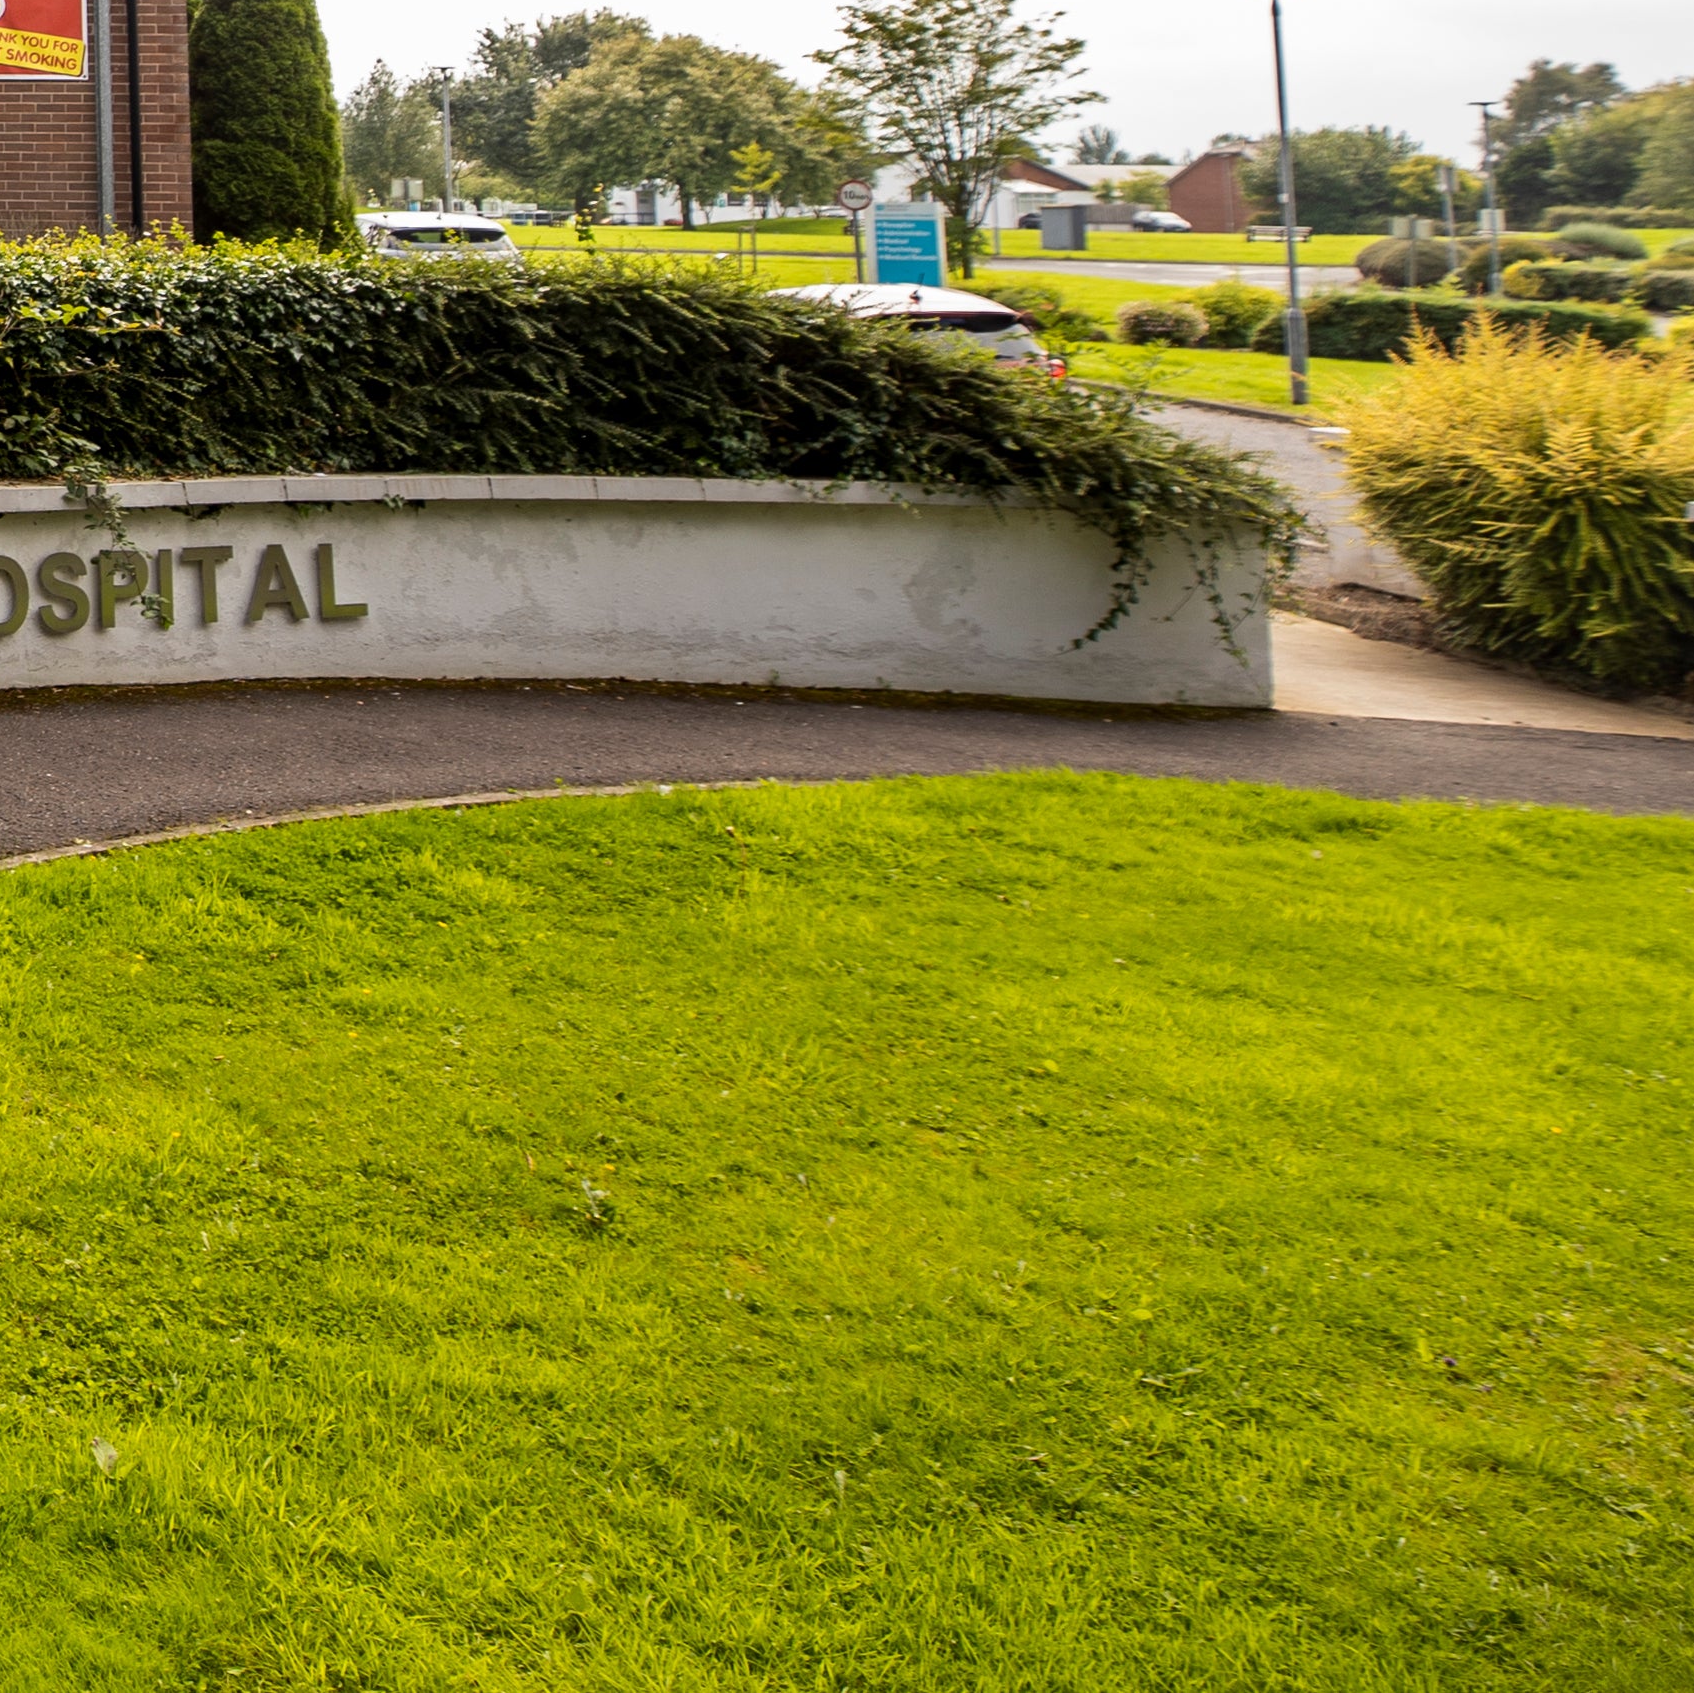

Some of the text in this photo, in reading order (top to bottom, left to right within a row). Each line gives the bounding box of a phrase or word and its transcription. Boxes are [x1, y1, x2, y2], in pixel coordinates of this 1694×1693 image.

[21, 34, 50, 49] YOU
[53, 40, 79, 54] FOR
[6, 48, 78, 70] SMOKING
